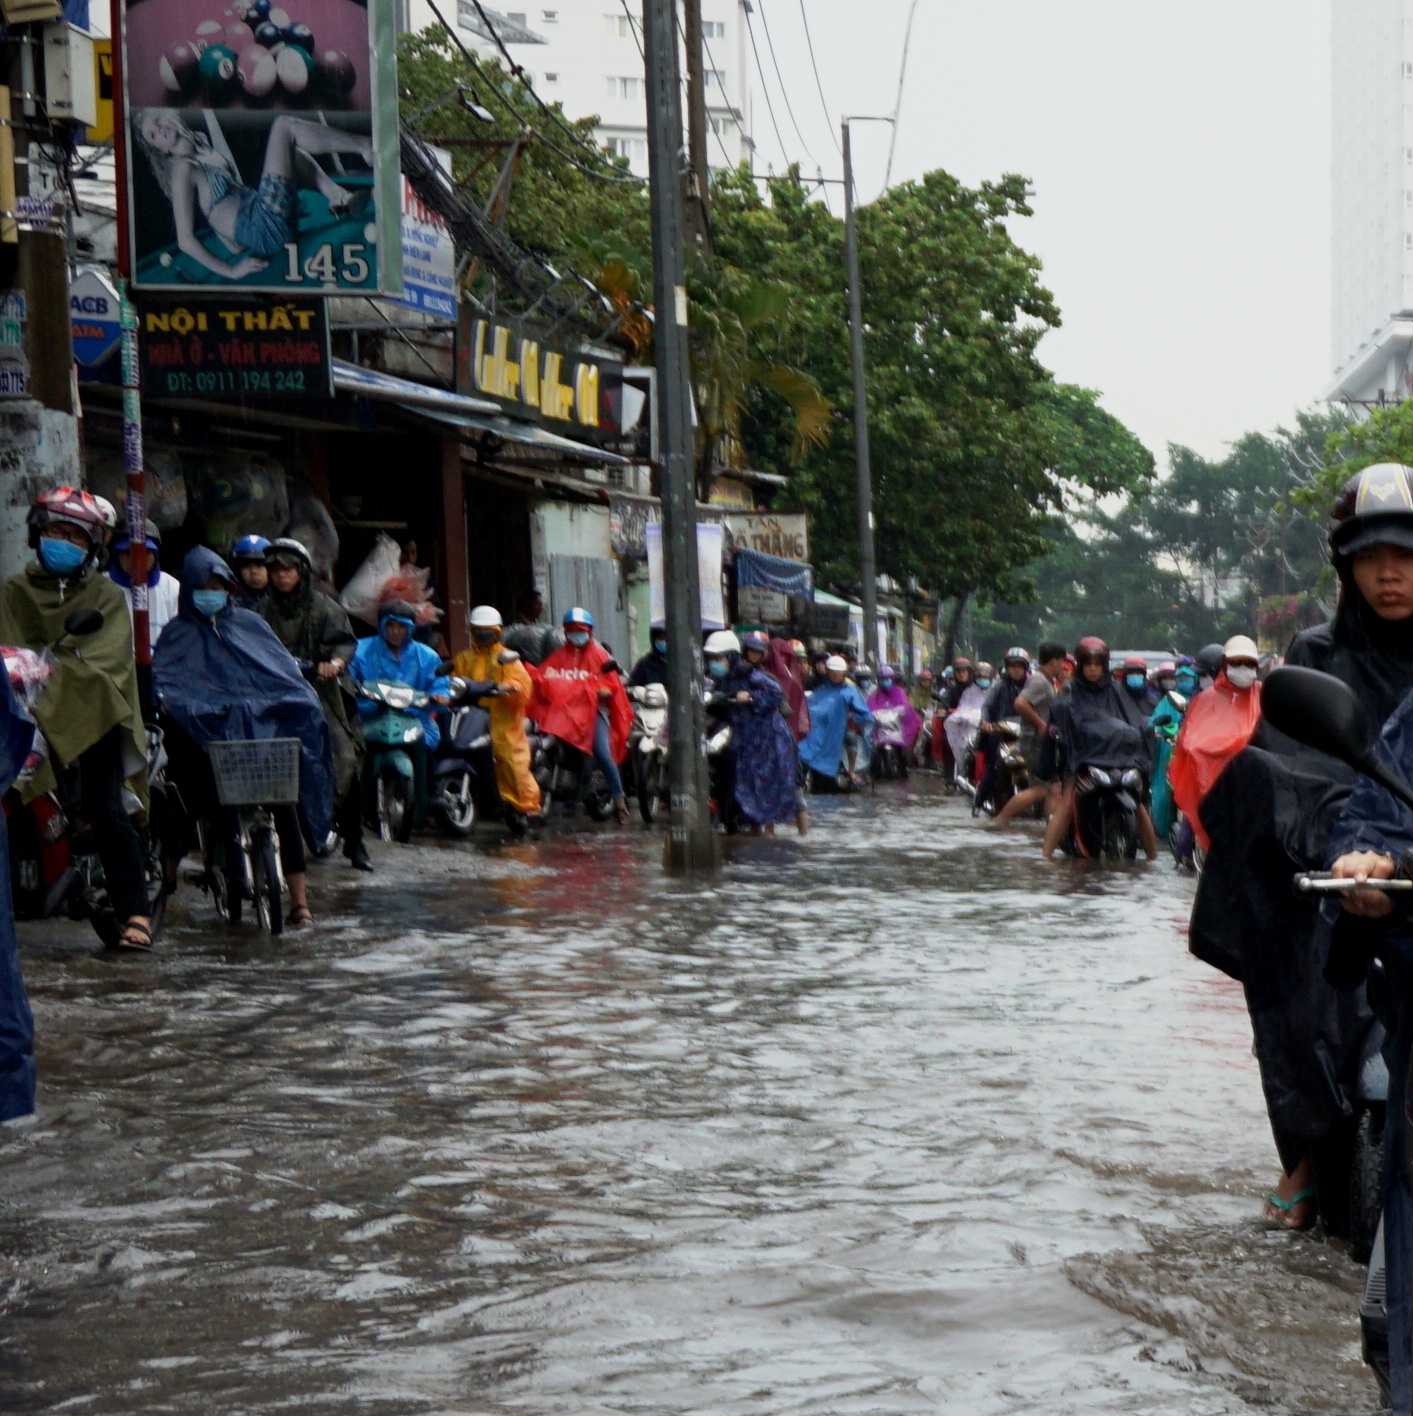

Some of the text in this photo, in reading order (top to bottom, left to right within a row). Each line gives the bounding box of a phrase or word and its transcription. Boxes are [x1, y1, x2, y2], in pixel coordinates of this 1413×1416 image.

[283, 242, 370, 283] 145
[146, 302, 316, 336] NỘI THẤT
[195, 371, 235, 391] 0911
[243, 371, 271, 390] 194
[275, 371, 306, 390] 242
